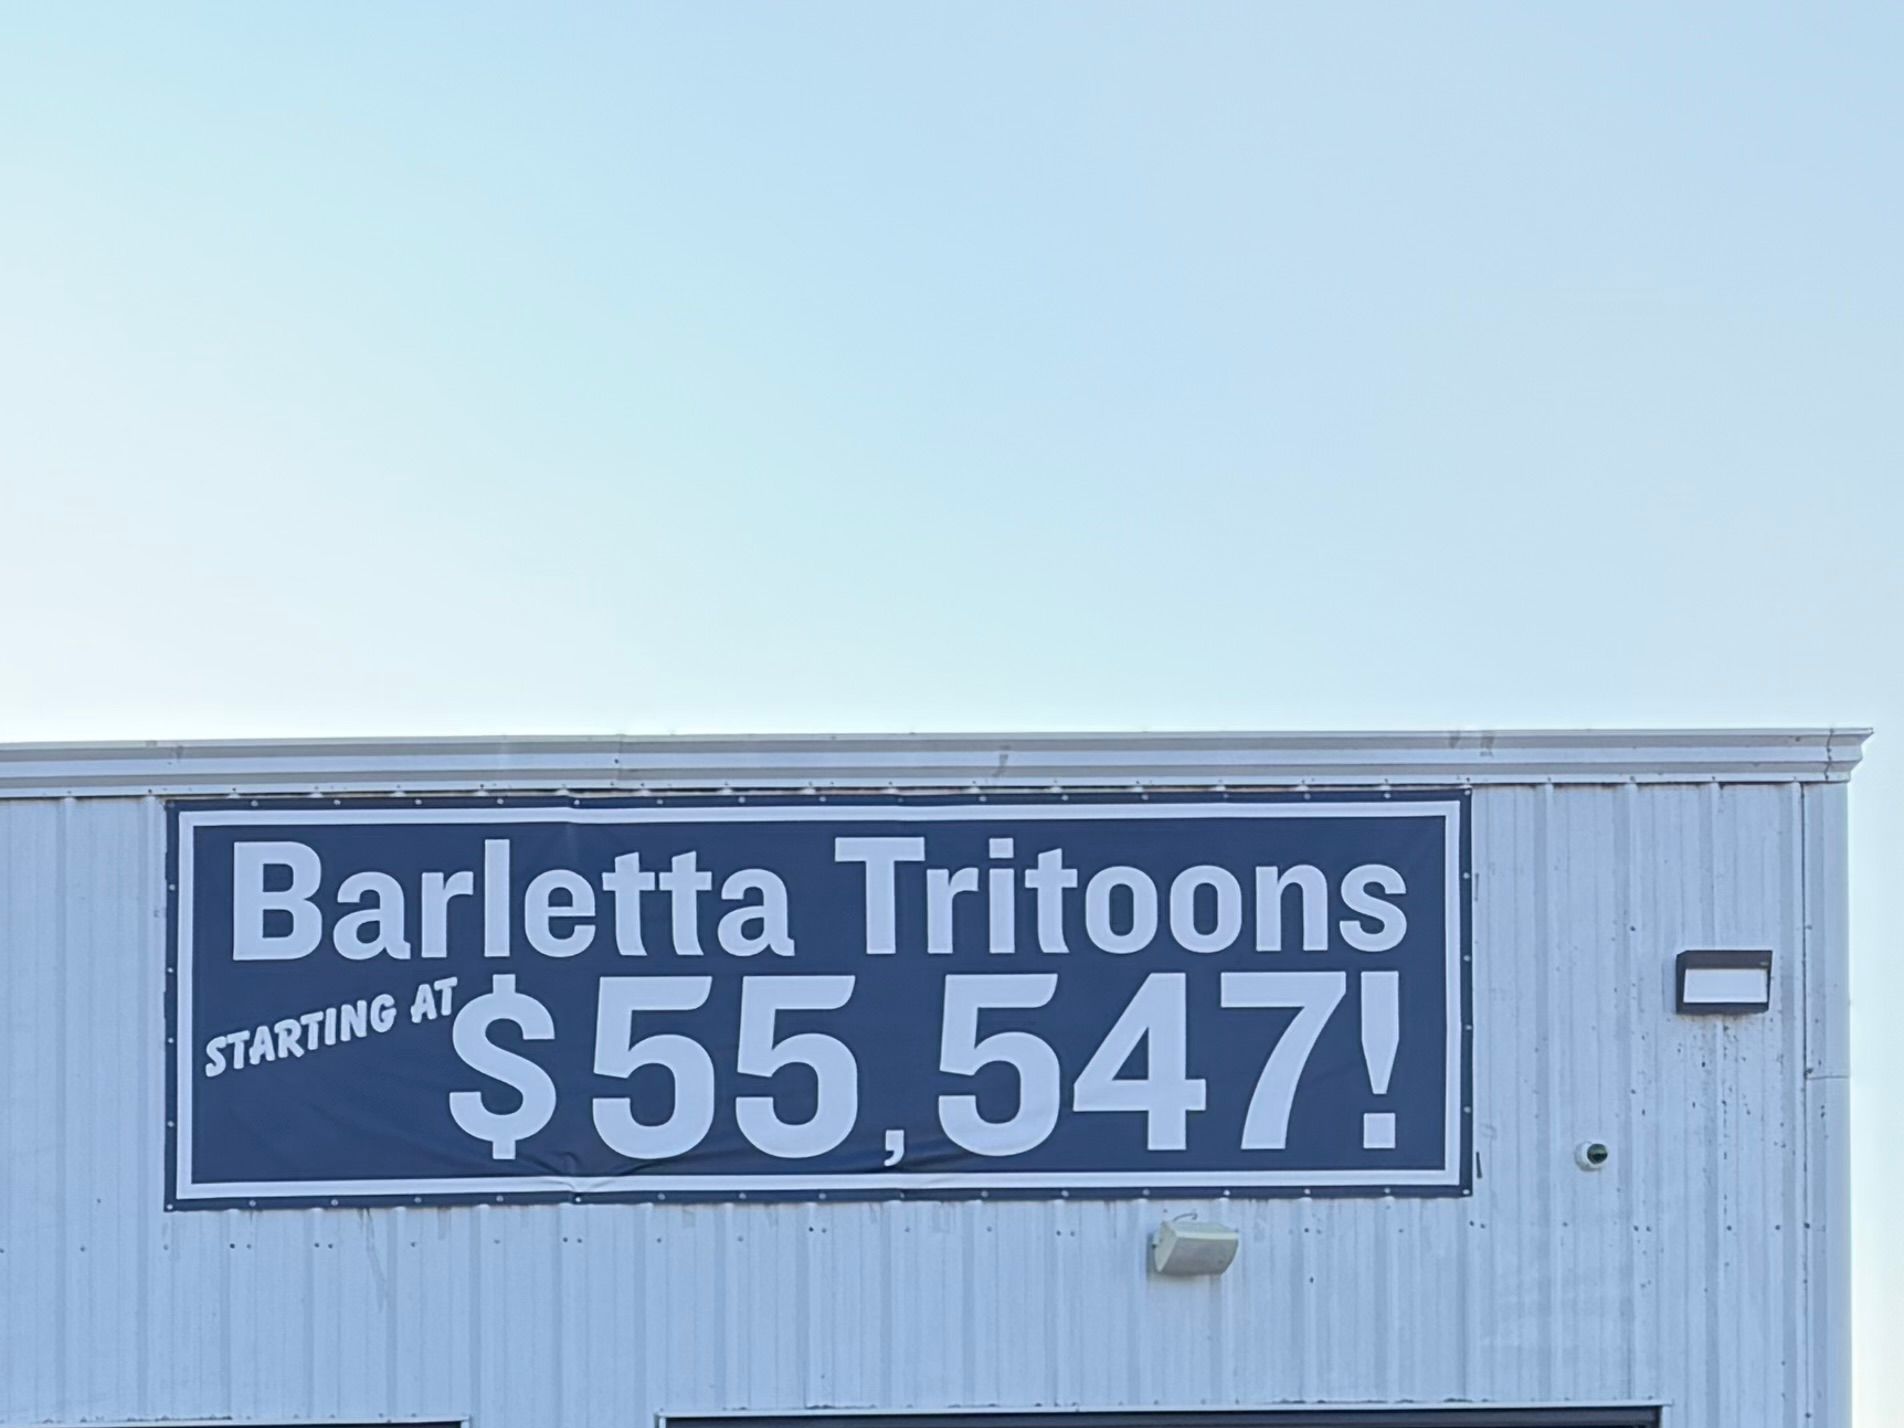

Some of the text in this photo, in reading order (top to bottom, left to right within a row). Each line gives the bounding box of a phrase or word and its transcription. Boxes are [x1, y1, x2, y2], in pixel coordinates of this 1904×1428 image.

[230, 835, 1409, 962] Barletta Tritoons
[203, 975, 459, 1080] STARTING AT
